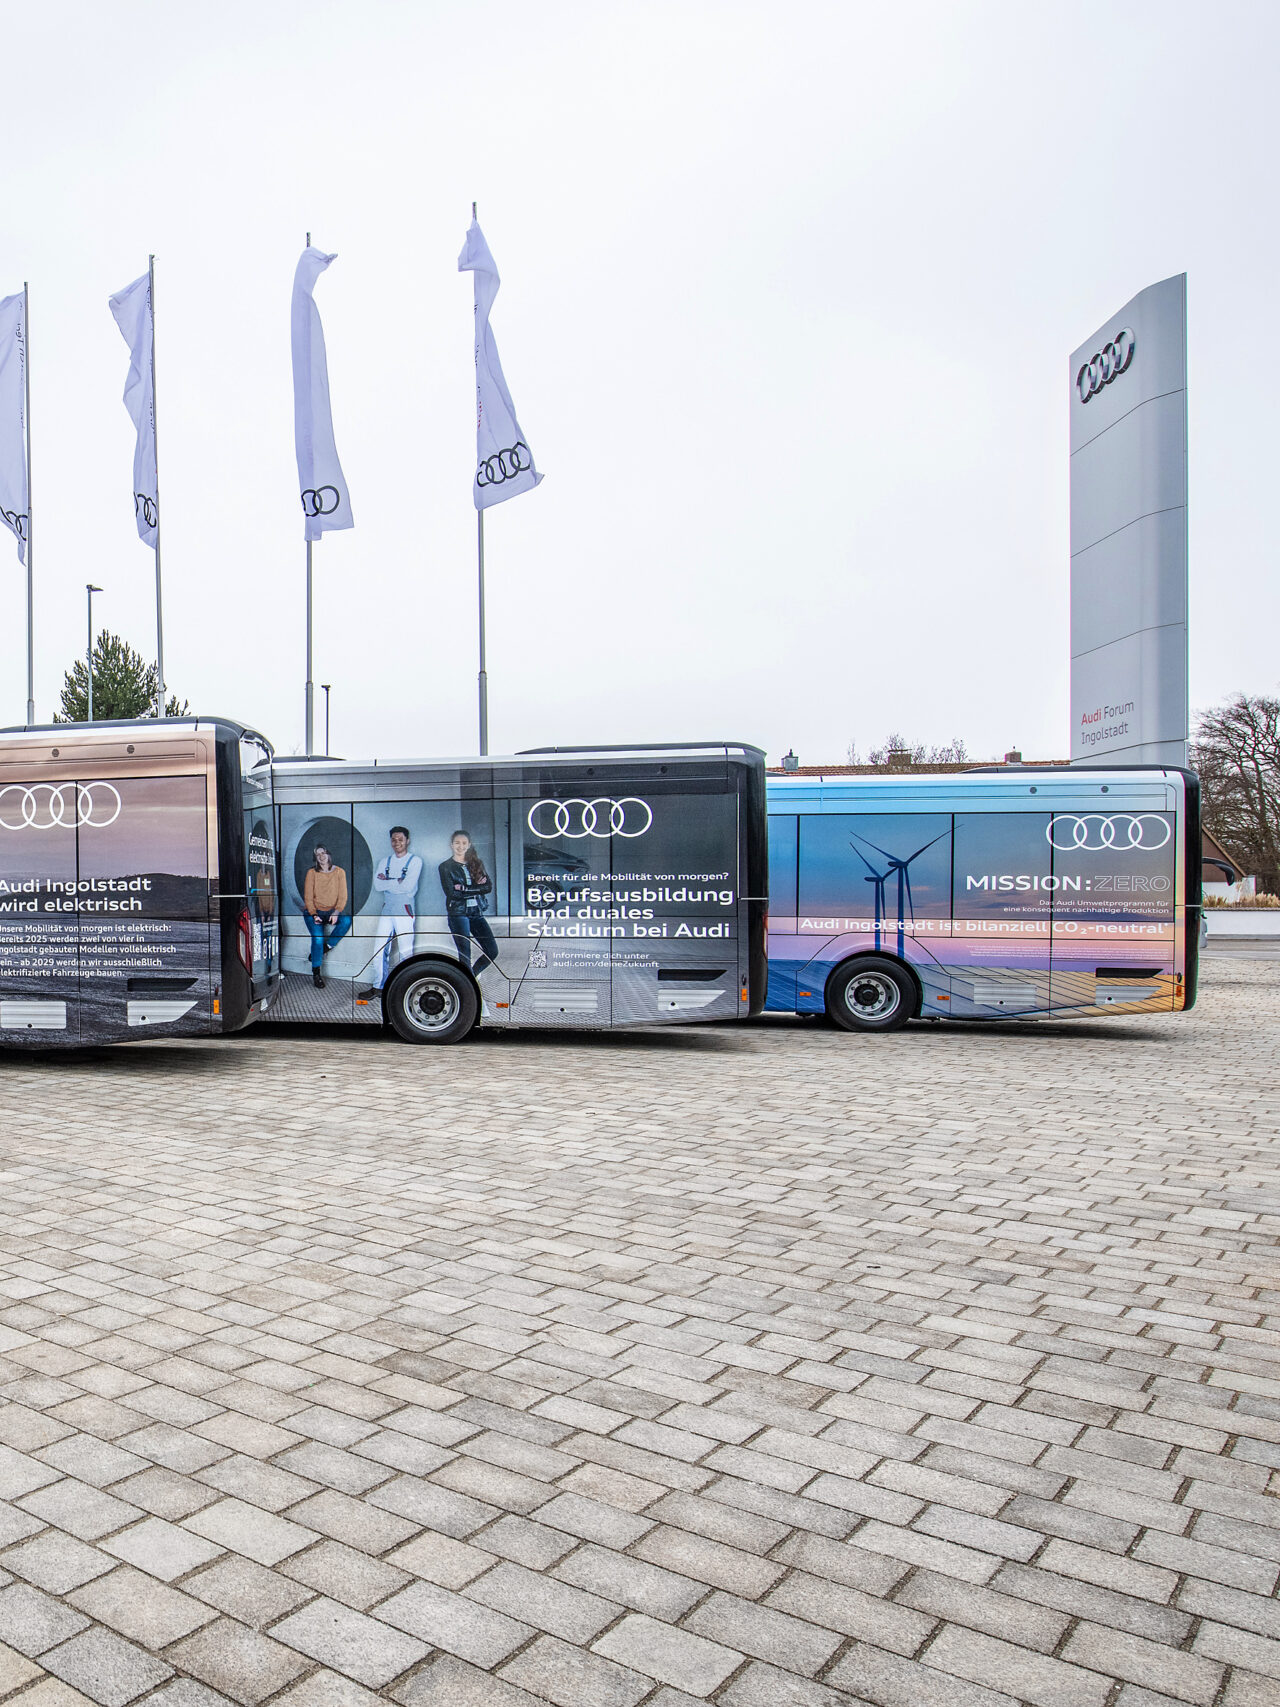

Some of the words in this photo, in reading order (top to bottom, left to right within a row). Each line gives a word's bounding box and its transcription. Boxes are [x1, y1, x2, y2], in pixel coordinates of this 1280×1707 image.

[1081, 709, 1102, 726] Audi
[1104, 701, 1135, 719] Forum
[1081, 722, 1129, 745] Ingolstadt
[527, 873, 560, 881] Bereit
[562, 873, 579, 881] für
[581, 873, 599, 881] die
[600, 873, 652, 881] Mobilität
[678, 872, 730, 882] morgen?
[47, 877, 152, 896] Ingolstadt
[527, 887, 734, 906] Berufsausbildung
[44, 897, 142, 912] elektrisch
[1022, 906, 1071, 914] konsequent
[1077, 900, 1155, 909] Umweltprogramm
[527, 905, 570, 920] und
[577, 905, 654, 920] duales
[25, 924, 62, 933] Mobilität
[80, 925, 113, 934] morgen
[114, 923, 126, 932] ist
[127, 923, 172, 932] elektrisch:
[527, 923, 625, 937] Studium
[633, 923, 667, 937] bei
[674, 923, 730, 937] Audi
[801, 918, 840, 930] Audi
[845, 919, 935, 932] Ingolstadt
[939, 920, 961, 931] ist
[966, 920, 1048, 932] bilanziell
[25, 935, 47, 943] 2025
[49, 935, 79, 943] werden
[81, 935, 100, 943] zwei
[118, 935, 135, 943] vier
[136, 935, 145, 943] in
[39, 945, 78, 955] gebauten
[79, 945, 118, 953] Modellen
[119, 945, 177, 953] vollelektrisch
[624, 952, 650, 960] unter
[20, 958, 31, 966] ab
[32, 958, 55, 966] 2029
[87, 958, 102, 966] wir
[103, 958, 162, 966] ausschließlich
[52, 968, 95, 978] Fahrzeuge
[96, 968, 125, 977] bauen.
